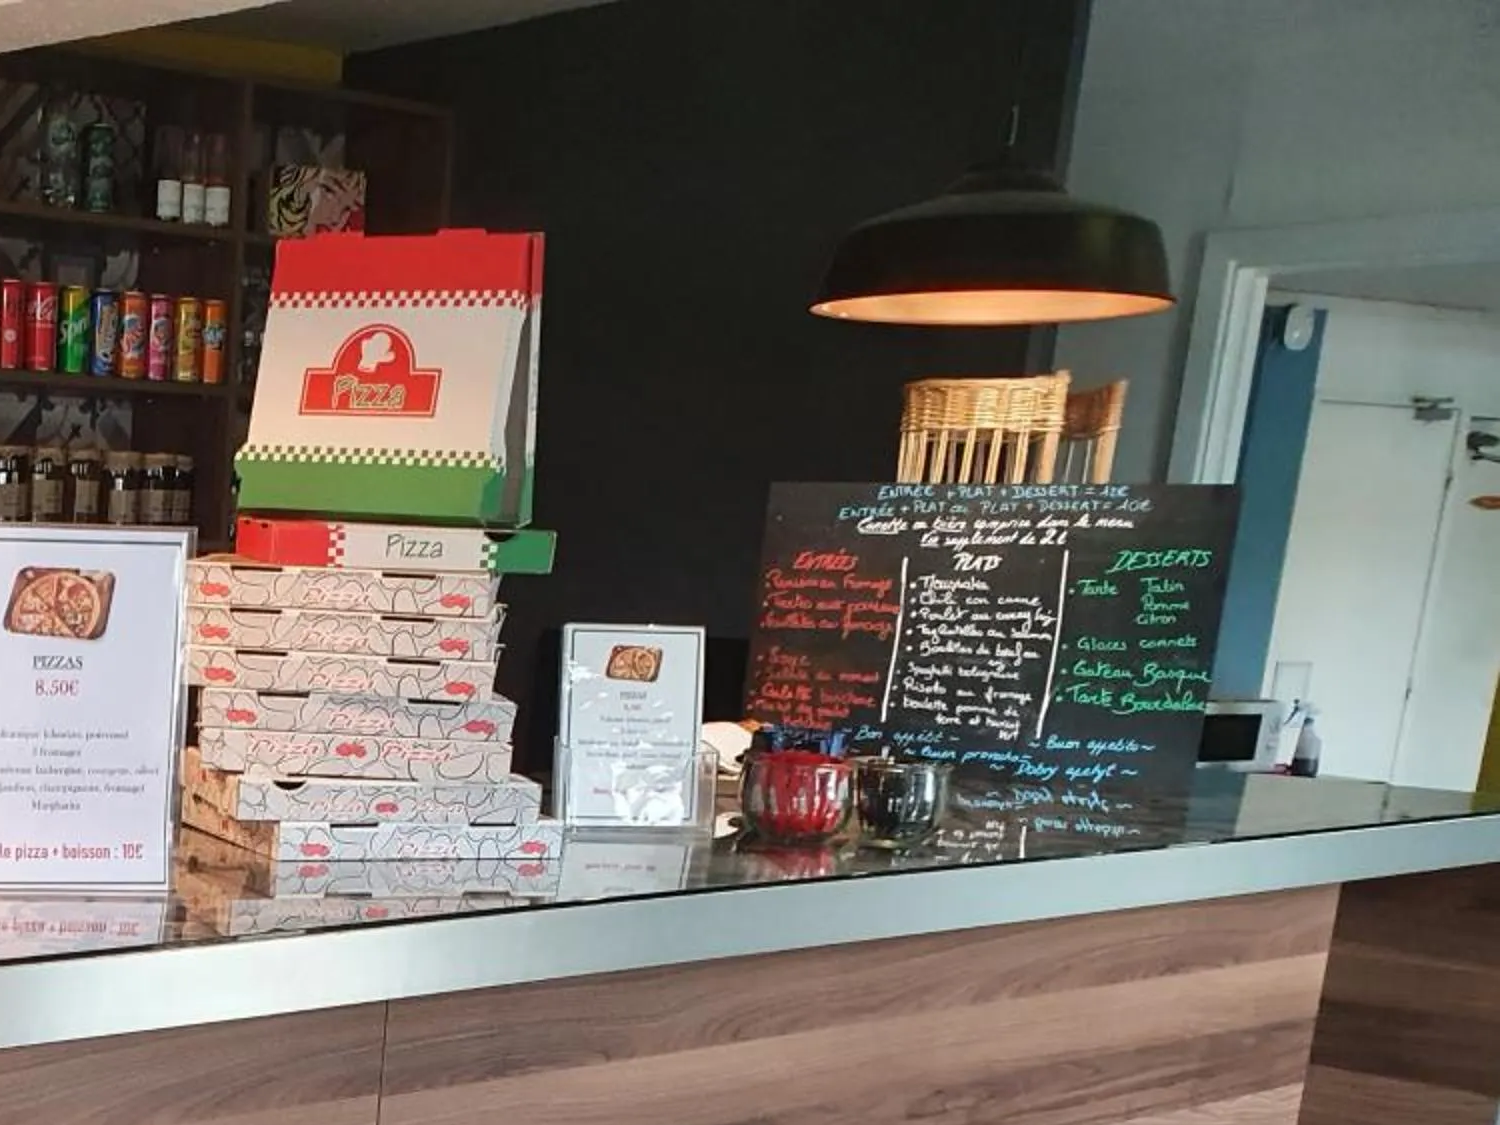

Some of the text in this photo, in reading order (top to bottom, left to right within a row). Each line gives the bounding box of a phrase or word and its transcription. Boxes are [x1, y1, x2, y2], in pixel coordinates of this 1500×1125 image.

[332, 374, 407, 411] Pizza
[957, 487, 993, 499] PLAT
[1012, 485, 1079, 499] DESSERT
[913, 500, 945, 513] PLAT
[980, 501, 1018, 513] PLAT
[1040, 500, 1099, 513] DESSERT
[1037, 514, 1068, 529] dans
[1095, 519, 1135, 530] menu
[385, 533, 443, 559] Pizza
[1105, 549, 1212, 574] DESSERTS
[1077, 577, 1185, 595] Tarte Tatin
[965, 597, 990, 605] con
[997, 596, 1042, 606] carne
[1140, 593, 1190, 611] Pomme
[919, 607, 969, 622] Poulet
[971, 612, 991, 621] au
[1134, 613, 1177, 625] Citron
[1078, 637, 1127, 651] Glaces
[32, 655, 83, 671] PIZZAS
[1133, 663, 1212, 693] Basque
[1066, 683, 1113, 706] Tarte
[855, 725, 882, 740] Bon
[1013, 760, 1059, 780] Dobry
[15, 844, 49, 861] pizza
[62, 844, 110, 859] boisson
[122, 843, 143, 859] 10€
